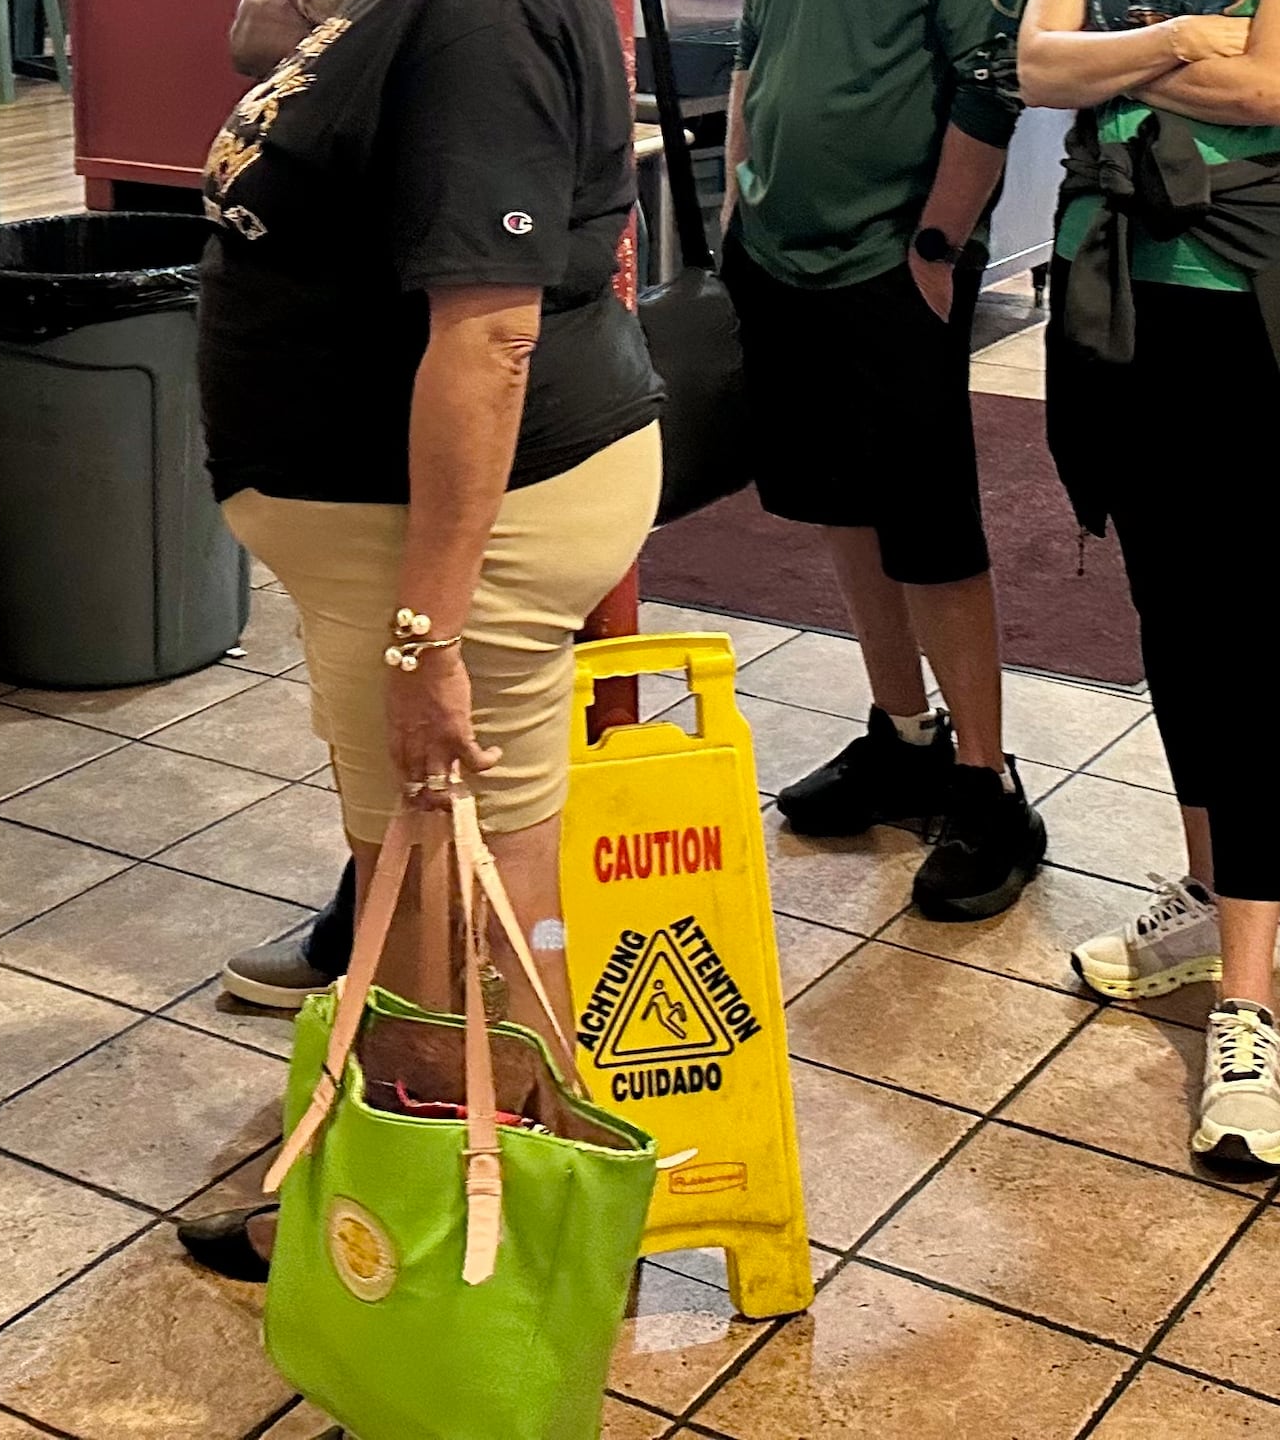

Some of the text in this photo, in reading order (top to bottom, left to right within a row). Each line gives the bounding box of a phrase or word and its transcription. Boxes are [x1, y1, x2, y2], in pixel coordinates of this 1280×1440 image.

[594, 826, 722, 883] CAUTION
[577, 929, 647, 1052] ACHTUNG
[670, 915, 762, 1043] ATTENTION
[612, 1062, 722, 1102] CUIDADO
